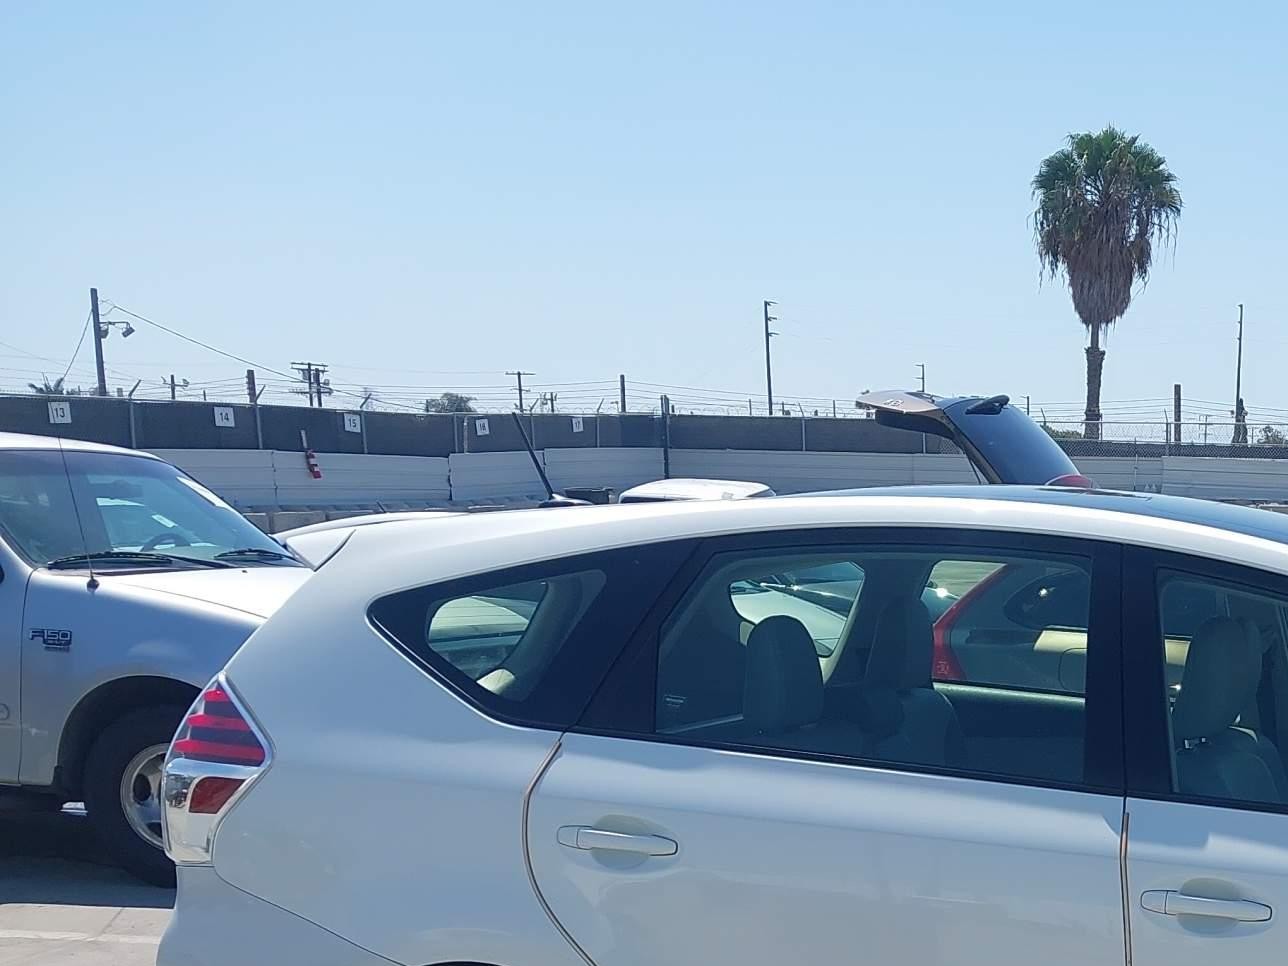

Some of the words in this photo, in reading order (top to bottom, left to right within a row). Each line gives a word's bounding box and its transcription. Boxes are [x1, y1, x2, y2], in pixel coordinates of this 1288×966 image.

[54, 407, 66, 418] 13
[219, 412, 230, 422] 14
[348, 418, 357, 428] 15
